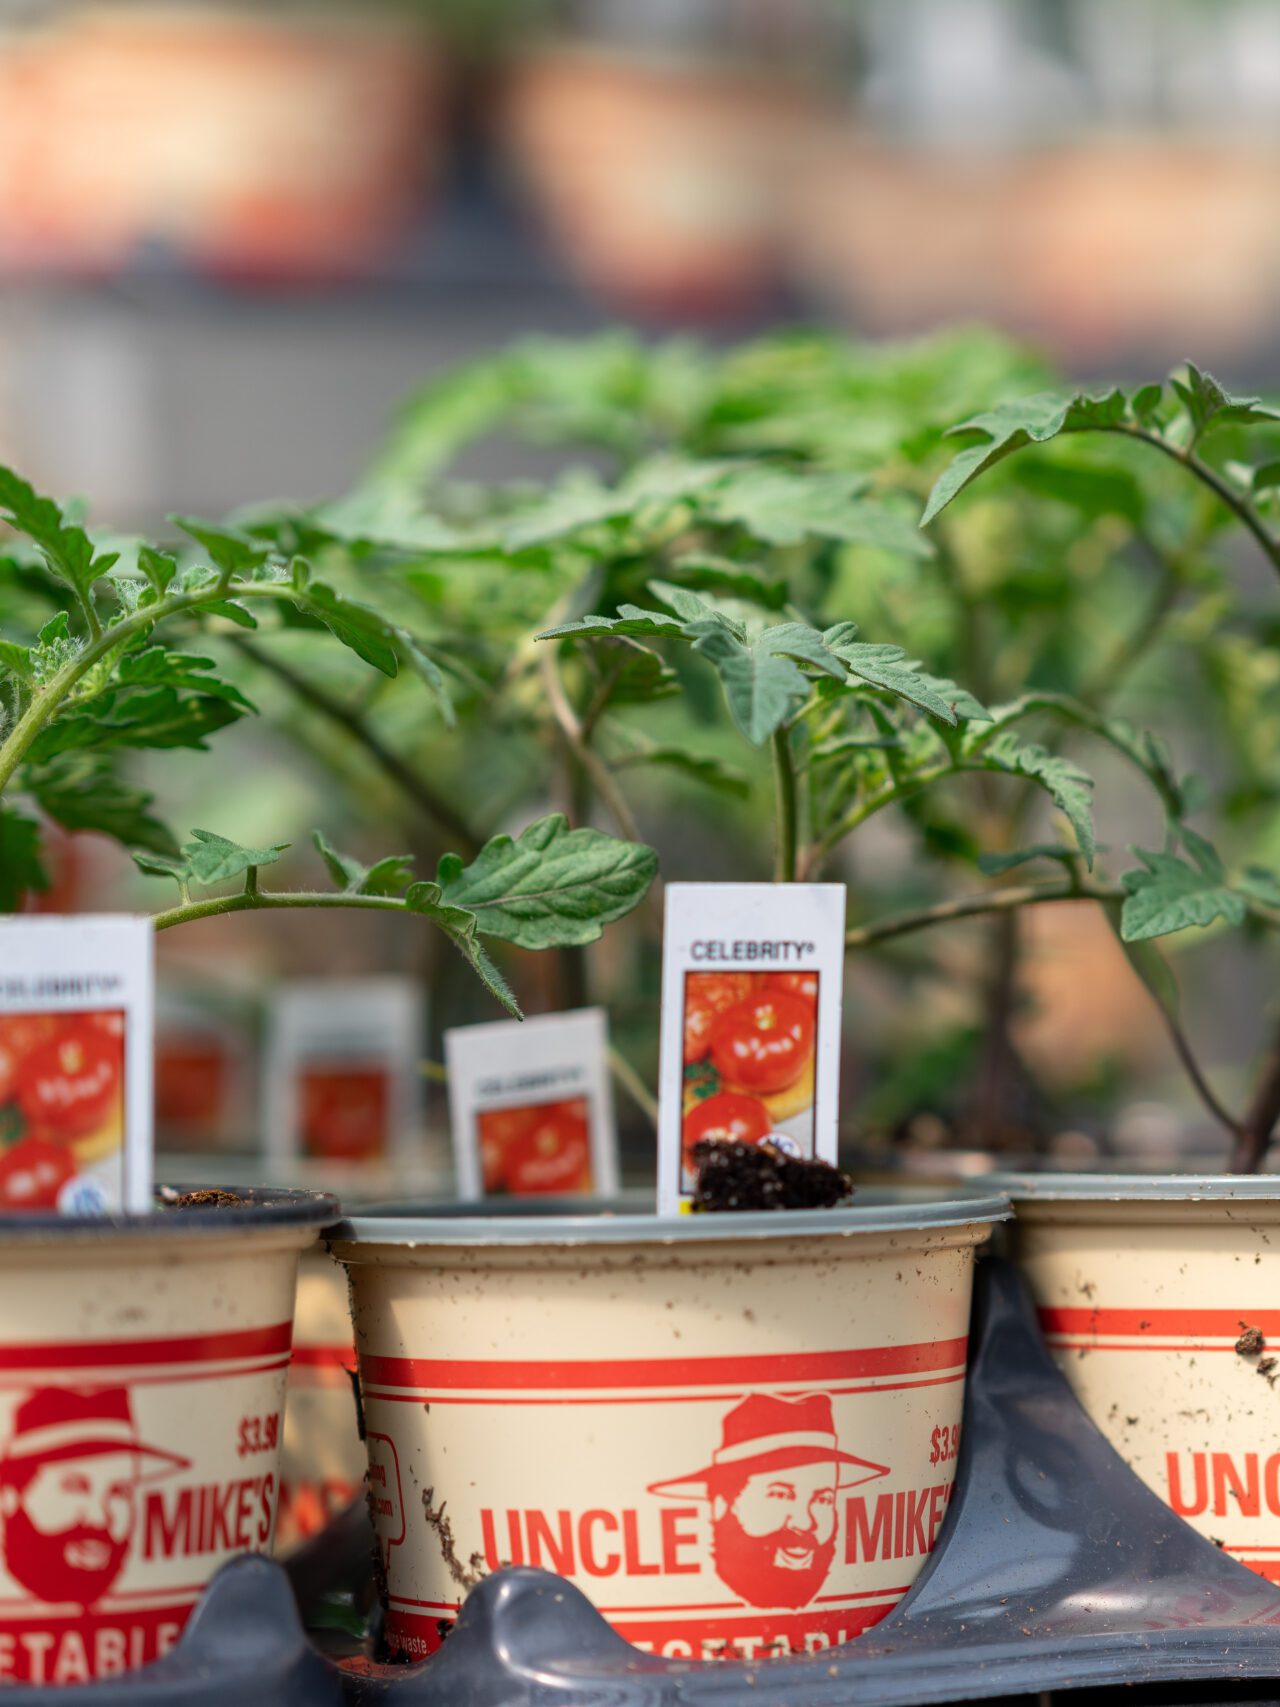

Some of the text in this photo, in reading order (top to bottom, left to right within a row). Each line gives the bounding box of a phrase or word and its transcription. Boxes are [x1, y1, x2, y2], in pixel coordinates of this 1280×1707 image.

[145, 1472, 275, 1561] MIKE'S
[480, 1482, 956, 1578] UNCLE MIKE'
